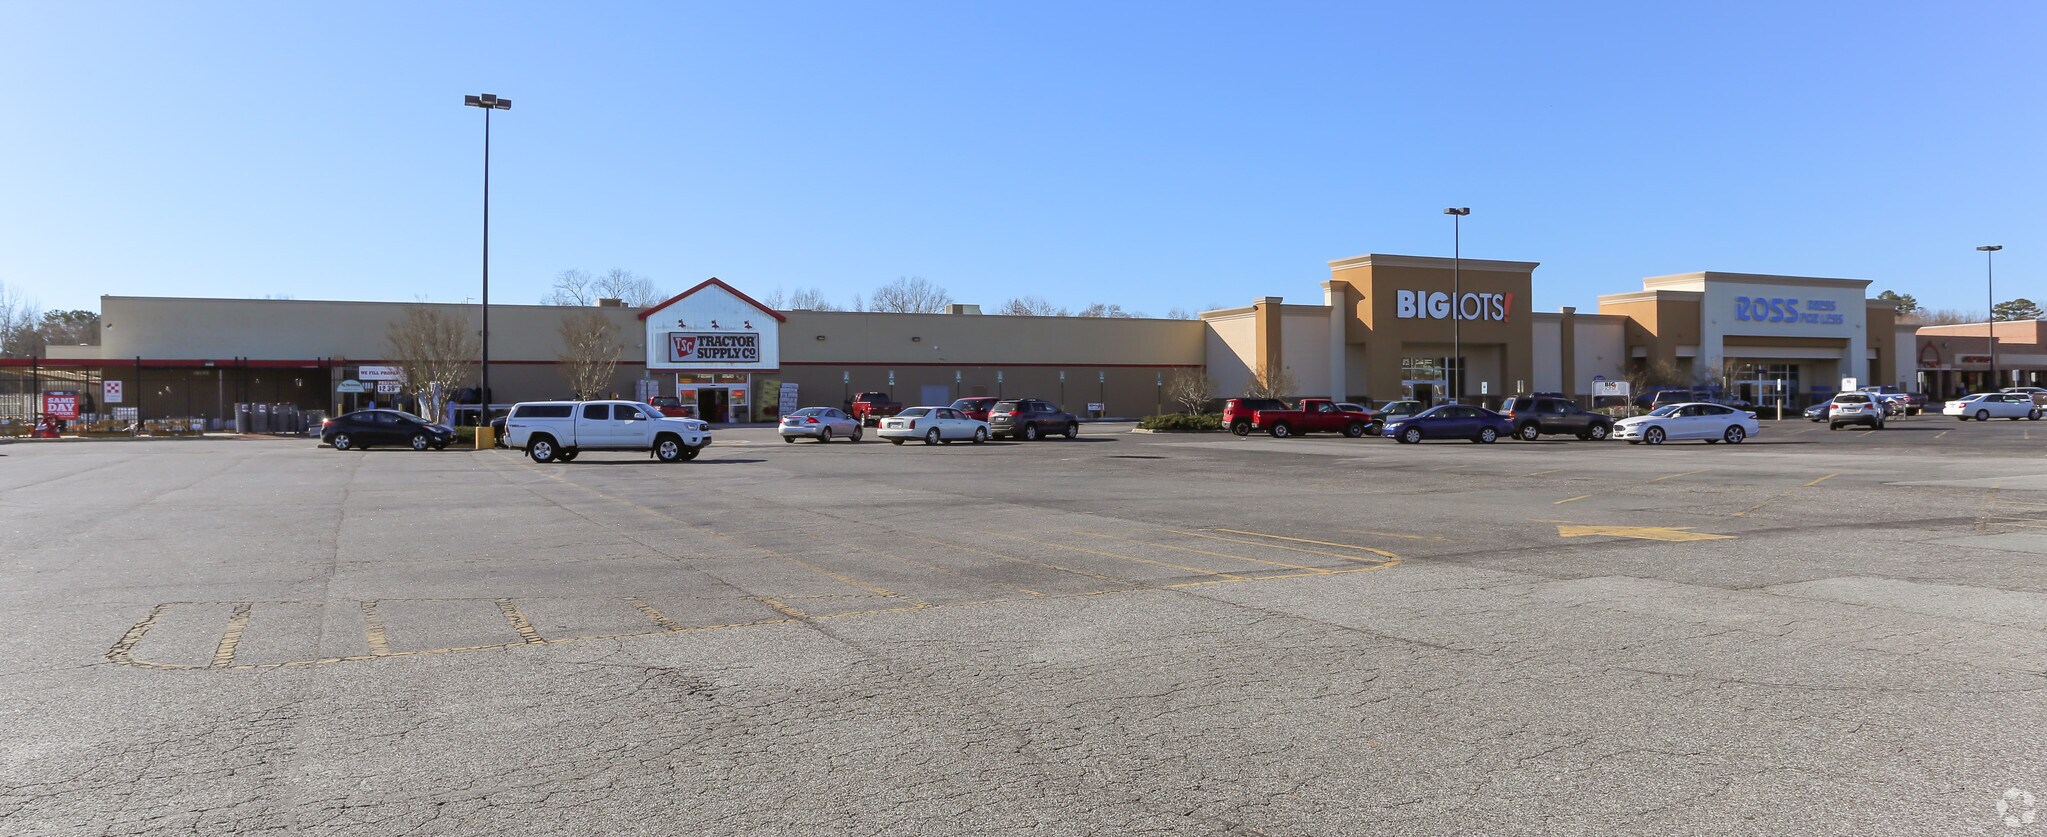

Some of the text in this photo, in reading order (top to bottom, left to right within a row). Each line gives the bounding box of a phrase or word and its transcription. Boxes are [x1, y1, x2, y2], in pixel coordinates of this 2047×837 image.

[1397, 289, 1513, 323] BIG LOTS!
[1735, 296, 1799, 323] ROSS
[675, 337, 693, 354] TSC
[697, 335, 755, 347] TRACTOR
[697, 347, 741, 359] SUPPLY
[47, 403, 75, 412] DAY
